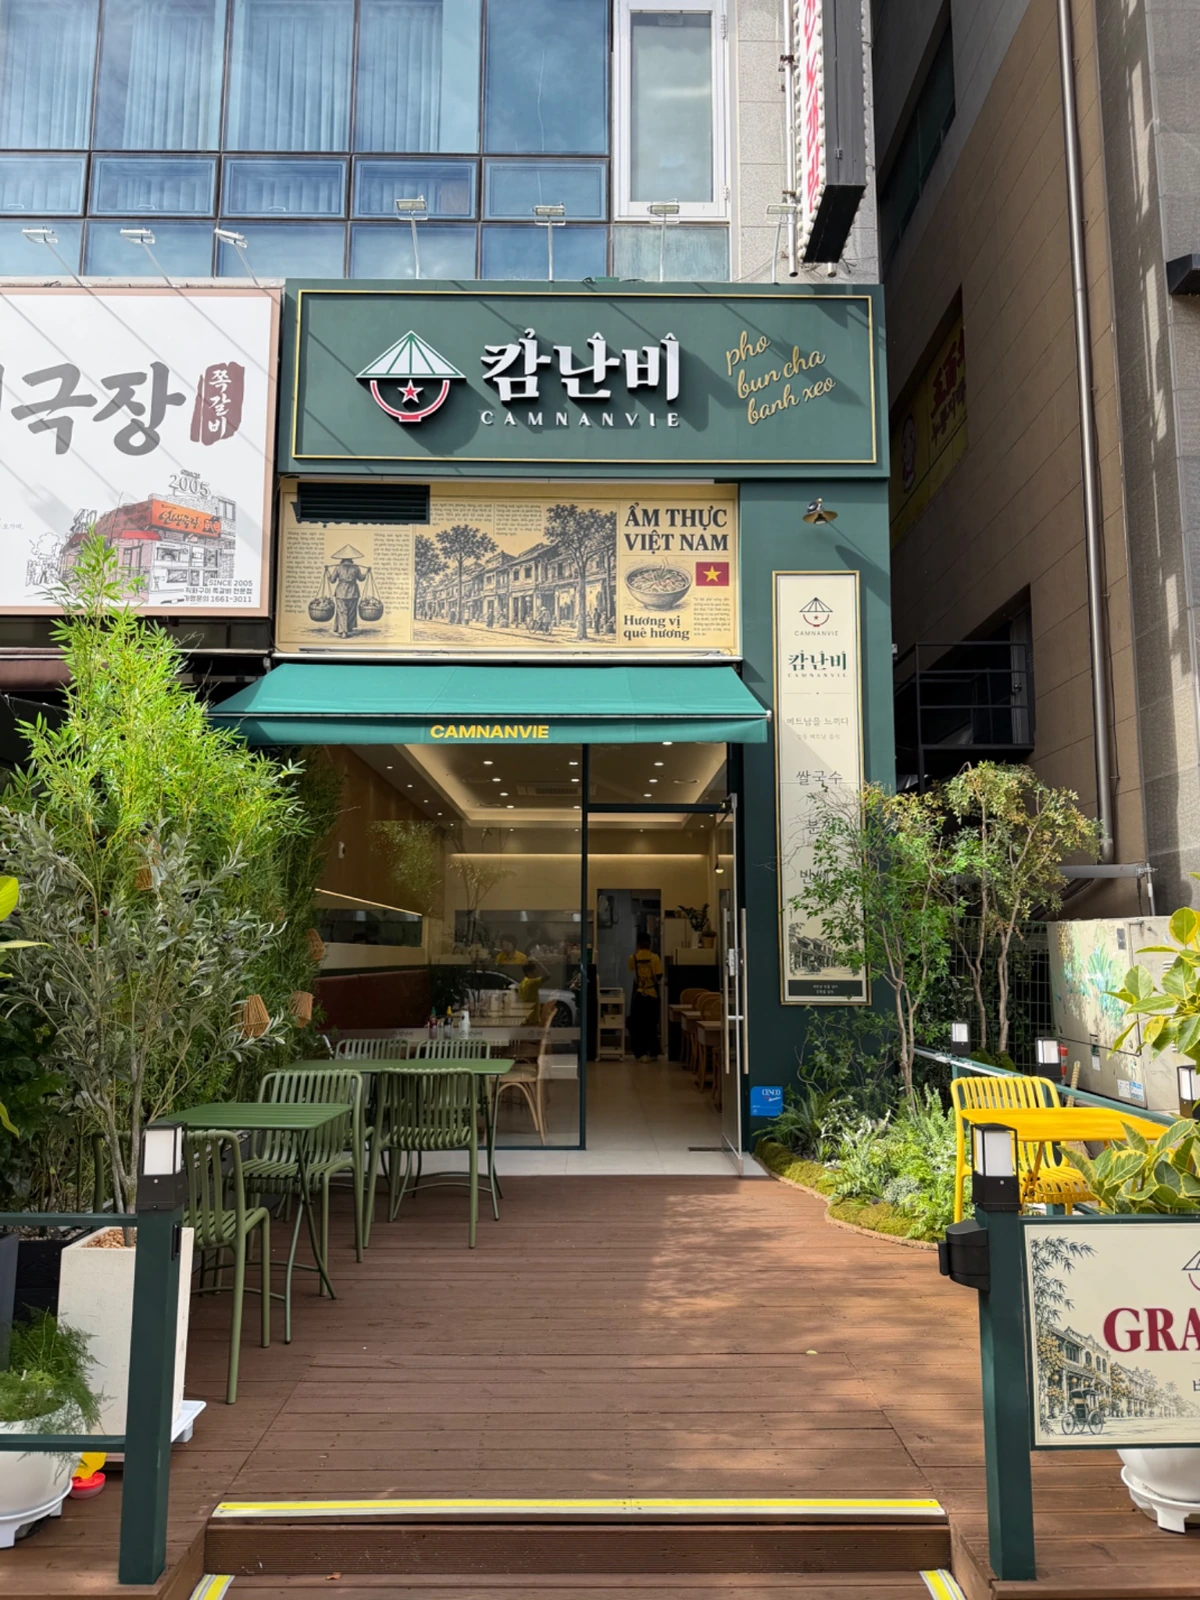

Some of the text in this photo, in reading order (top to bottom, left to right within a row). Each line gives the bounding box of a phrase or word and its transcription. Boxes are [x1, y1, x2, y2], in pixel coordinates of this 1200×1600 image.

[480, 328, 680, 402] 캄난비
[726, 330, 771, 376] pho
[737, 345, 826, 399] bun cha
[0, 362, 187, 457] 극장
[208, 369, 232, 439] 쪽갈비
[747, 377, 836, 425] banh xeo
[480, 411, 680, 428] CAMNANVIE
[168, 474, 211, 498] 2005
[624, 502, 727, 531] ẨM THỰC
[624, 530, 729, 554] VIỆT NAM
[624, 615, 680, 628] Hương vị
[624, 627, 690, 641] quê hương
[788, 650, 847, 672] 캄난비
[430, 724, 549, 738] CAMNANVIE
[796, 769, 843, 786] 쌀국수
